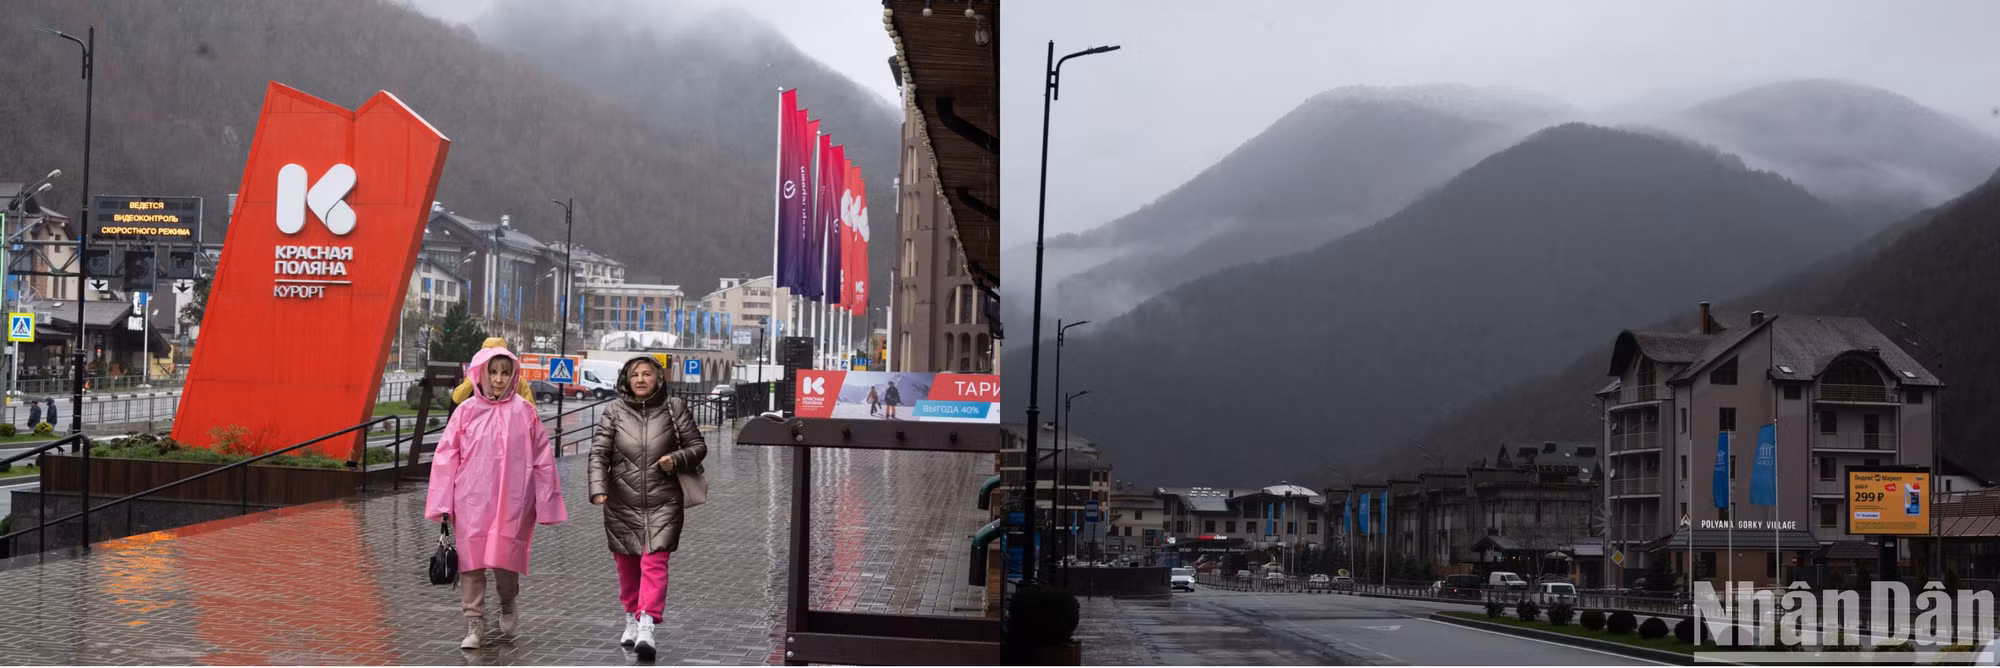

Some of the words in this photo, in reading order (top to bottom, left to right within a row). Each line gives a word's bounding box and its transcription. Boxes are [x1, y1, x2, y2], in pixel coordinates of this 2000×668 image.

[129, 202, 164, 210] ВЕДЕТСЯ
[113, 214, 179, 223] ВИДЕОКОНТРОЛЬ
[101, 227, 157, 235] СКОРОСТНОГО
[158, 228, 190, 236] РЕЖИМА
[275, 245, 353, 260] КРАСНАЯ
[274, 260, 347, 275] ПОЛЯНА
[273, 285, 326, 298] КУРОРТ
[688, 360, 698, 373] P
[922, 404, 959, 414] ВЫГОДА
[961, 405, 980, 414] 40%
[1855, 492, 1875, 502] 299
[1738, 520, 1763, 529] GORKY
[1766, 521, 1796, 530] VILLAGE
